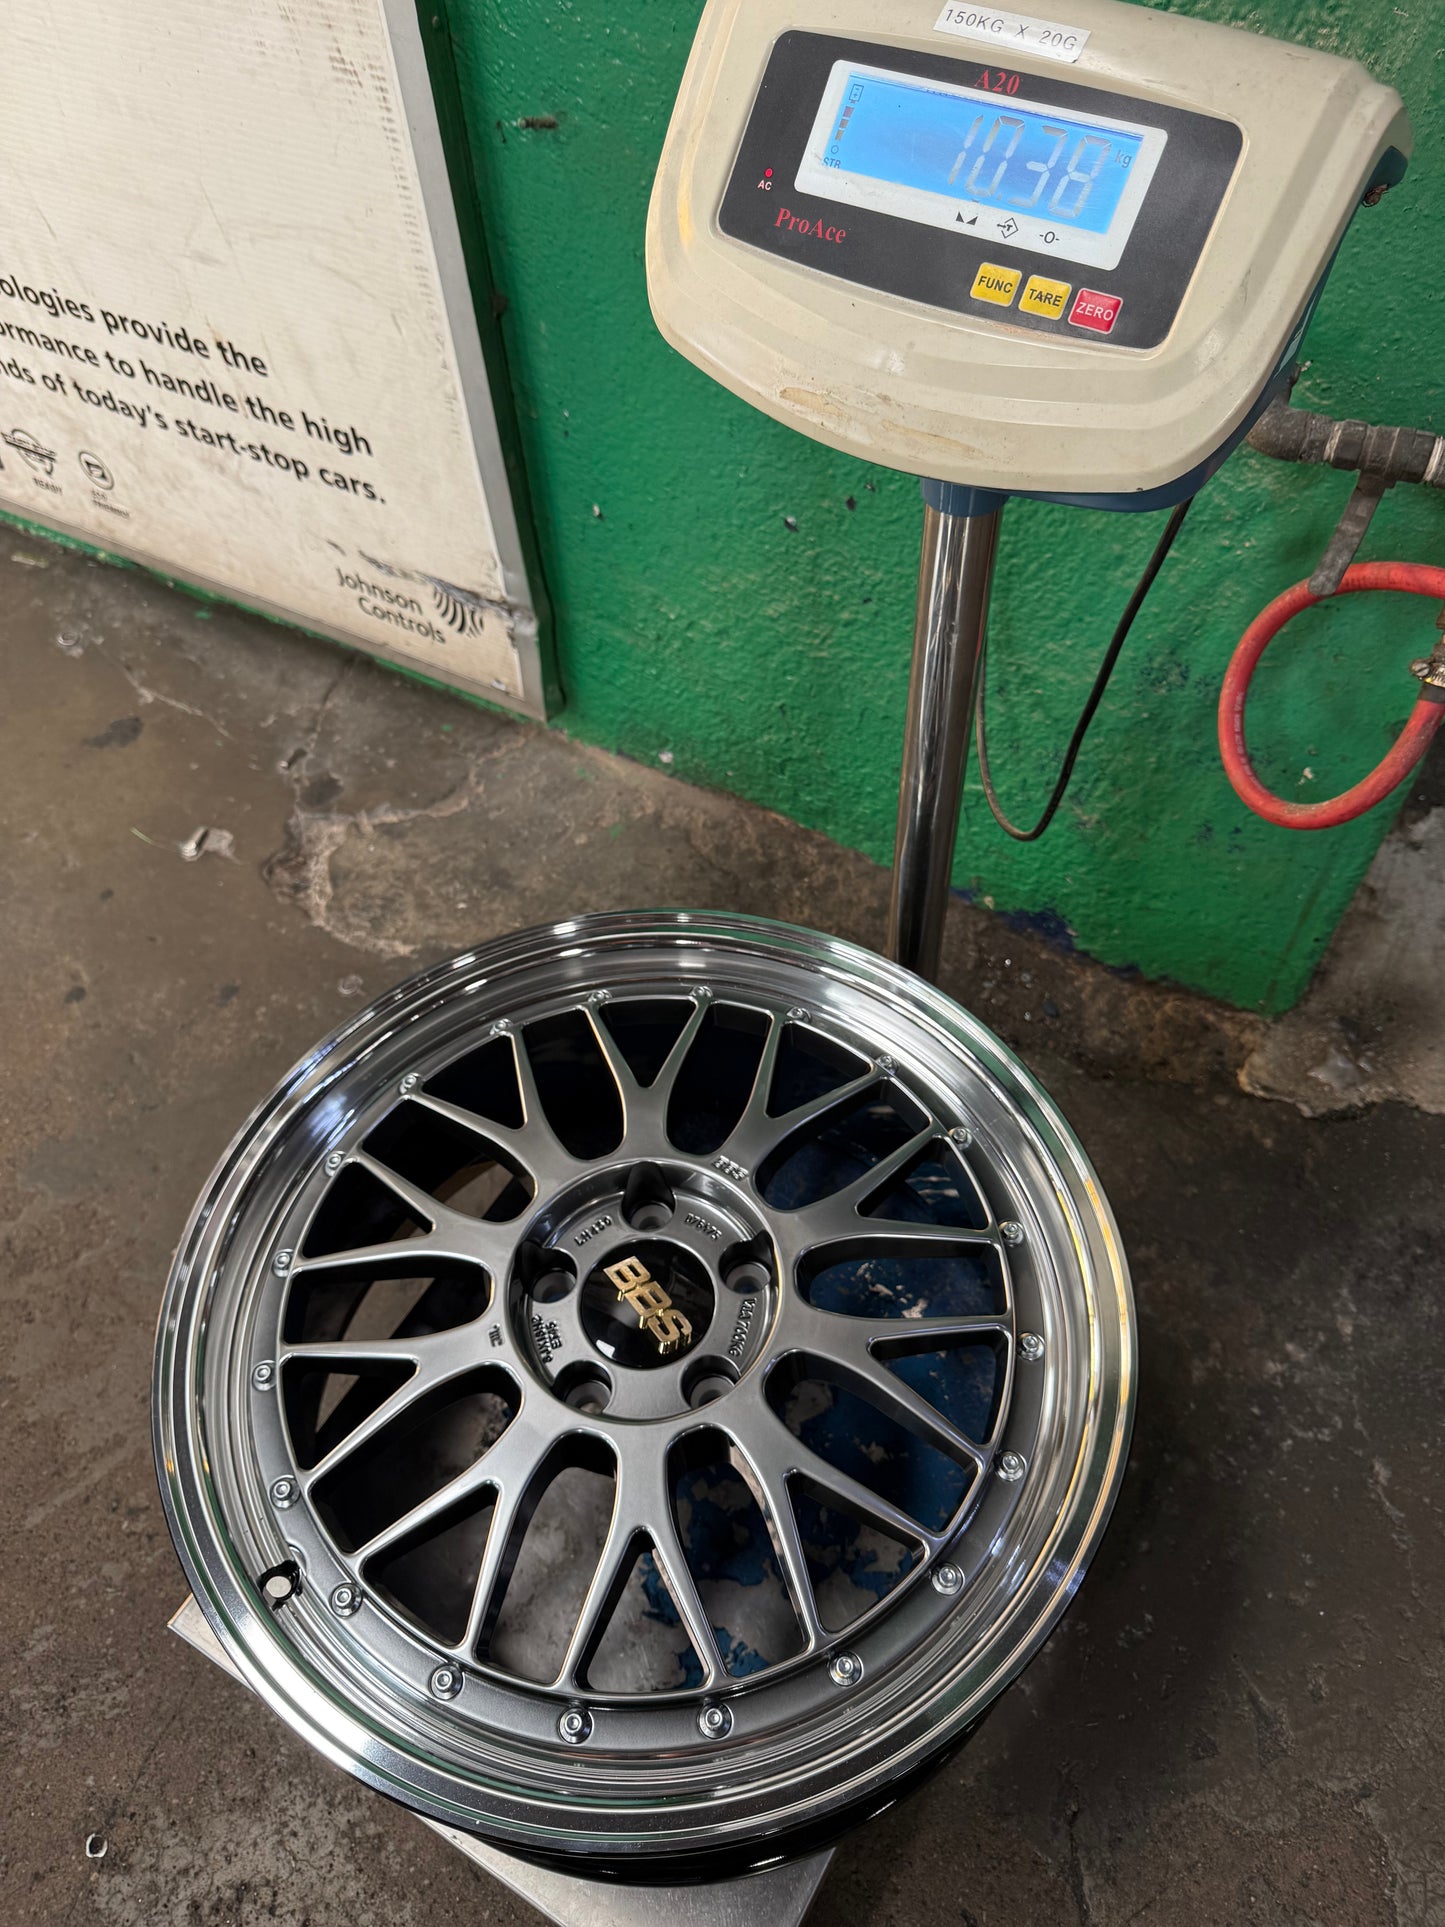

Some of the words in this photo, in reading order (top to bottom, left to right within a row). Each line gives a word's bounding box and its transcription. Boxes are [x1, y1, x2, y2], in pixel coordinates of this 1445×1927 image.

[945, 9, 1005, 33] 150KG
[1015, 24, 1029, 39] X
[1039, 30, 1078, 51] 20G
[974, 69, 1021, 96] A20
[1114, 149, 1133, 169] kg
[757, 179, 773, 191] AC
[774, 207, 847, 244] ProAce
[977, 275, 1014, 294] FUNC
[1028, 288, 1063, 308] TARE
[1076, 301, 1114, 322] ZERO
[100, 308, 210, 359] provide
[216, 340, 268, 377] the
[104, 351, 136, 378] to
[139, 359, 239, 412] handle
[245, 396, 295, 431] the
[301, 411, 372, 457] high
[42, 373, 67, 395] of
[73, 380, 169, 428] today's
[175, 418, 310, 482] start-stop
[319, 467, 386, 504] cars.
[336, 567, 423, 615] Johnson
[358, 596, 446, 644] Controls
[603, 1255, 693, 1347] BBS
